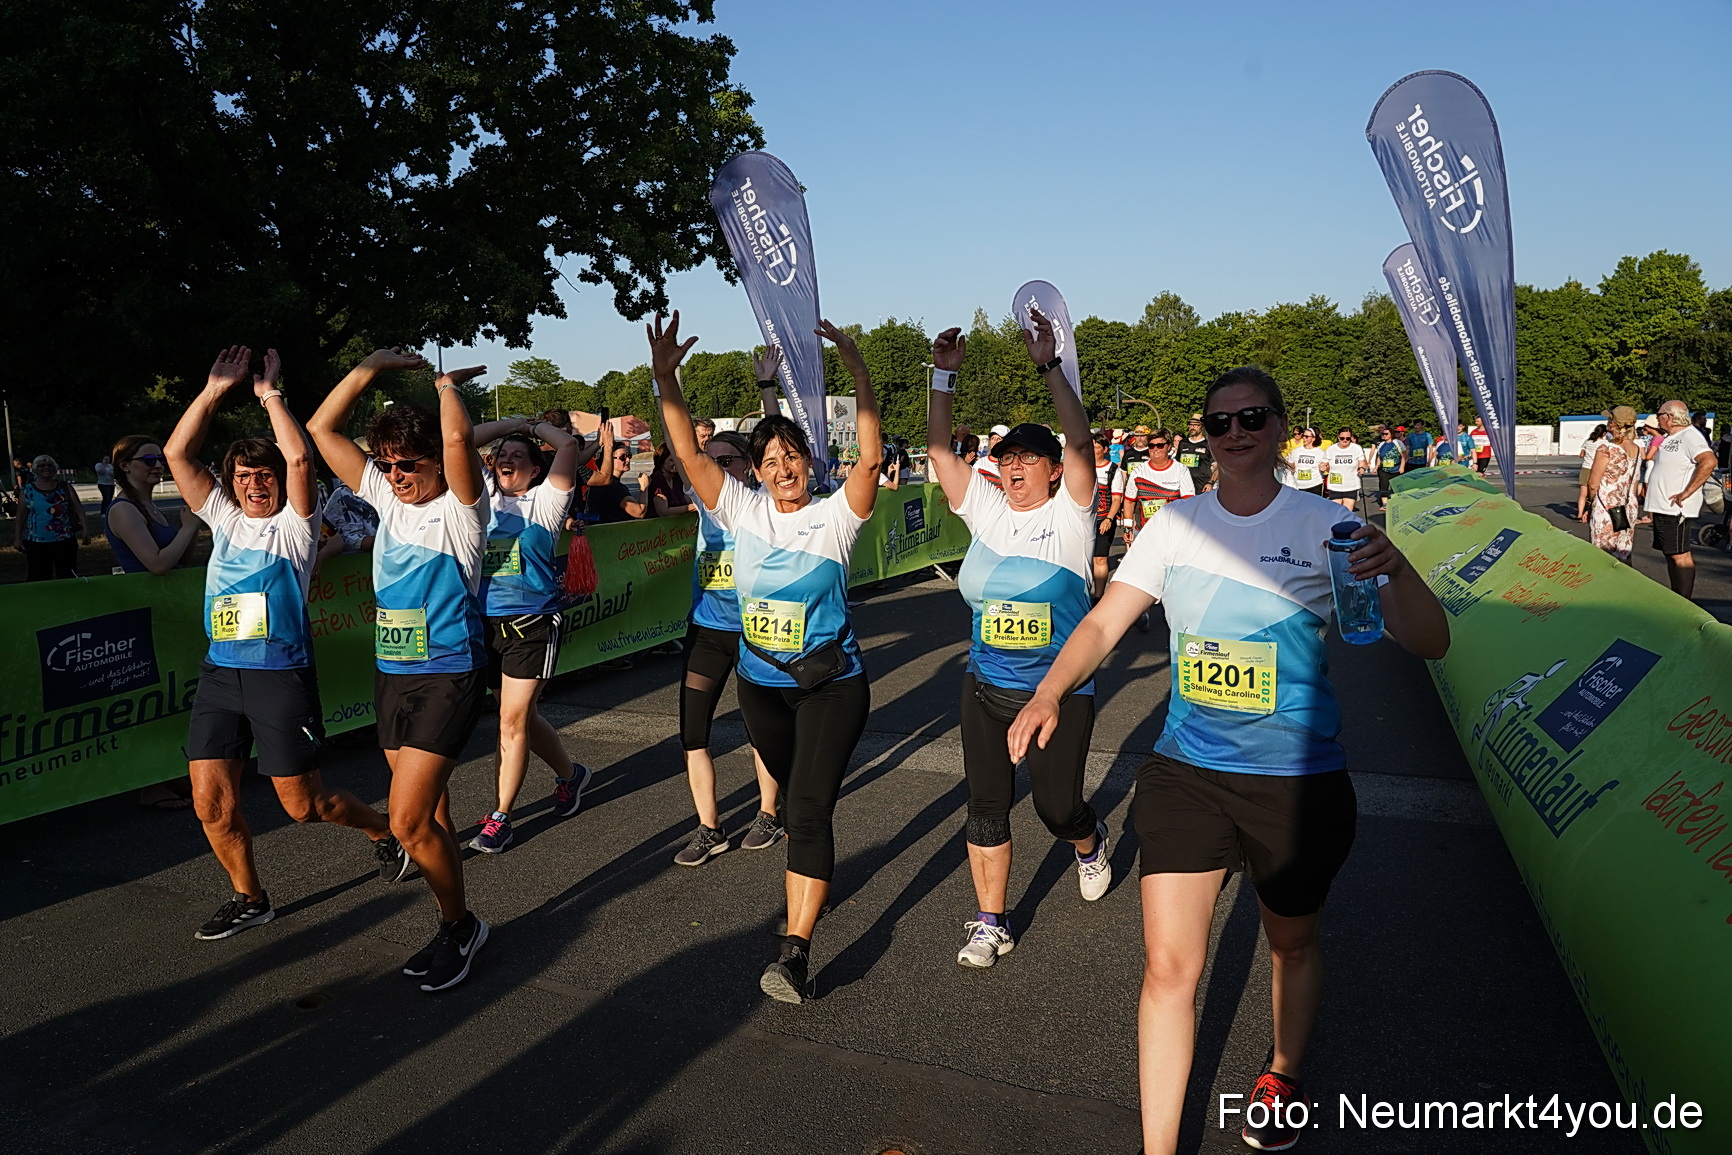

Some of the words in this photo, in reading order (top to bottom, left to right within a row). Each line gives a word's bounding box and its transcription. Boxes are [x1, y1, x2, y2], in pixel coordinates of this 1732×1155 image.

[669, 523, 697, 542] Firme
[899, 519, 942, 552] firmenlauf
[643, 552, 679, 576] laufen
[703, 564, 733, 578] 1210
[218, 609, 242, 627] 120
[311, 608, 358, 638] ufen
[562, 581, 633, 636] enlauf
[377, 626, 415, 644] 1207
[597, 619, 687, 653] www.firmenlauf-ober
[744, 616, 753, 639] WALK
[750, 615, 793, 636] 1214
[792, 622, 801, 646] 2022
[992, 617, 1040, 635] 1216
[1040, 621, 1048, 643] 2022
[65, 636, 136, 666] Fischer
[415, 629, 425, 654] 2022
[1200, 649, 1230, 658] Firmenlauf
[73, 651, 133, 673] AUTOMOBILE
[1183, 659, 1191, 693] WALK
[1193, 659, 1255, 690] 1201
[1190, 682, 1223, 697] Stellwag
[1224, 688, 1261, 700] Caroline
[1261, 671, 1271, 704] 2022
[1585, 669, 1624, 700] Fischer
[0, 671, 199, 762] firmenla
[1667, 695, 1732, 766] Gesun
[0, 735, 119, 787] neumarkt
[1488, 704, 1620, 839] firmenlauf
[1485, 758, 1514, 808] neumarkt
[1641, 770, 1728, 854] laufen
